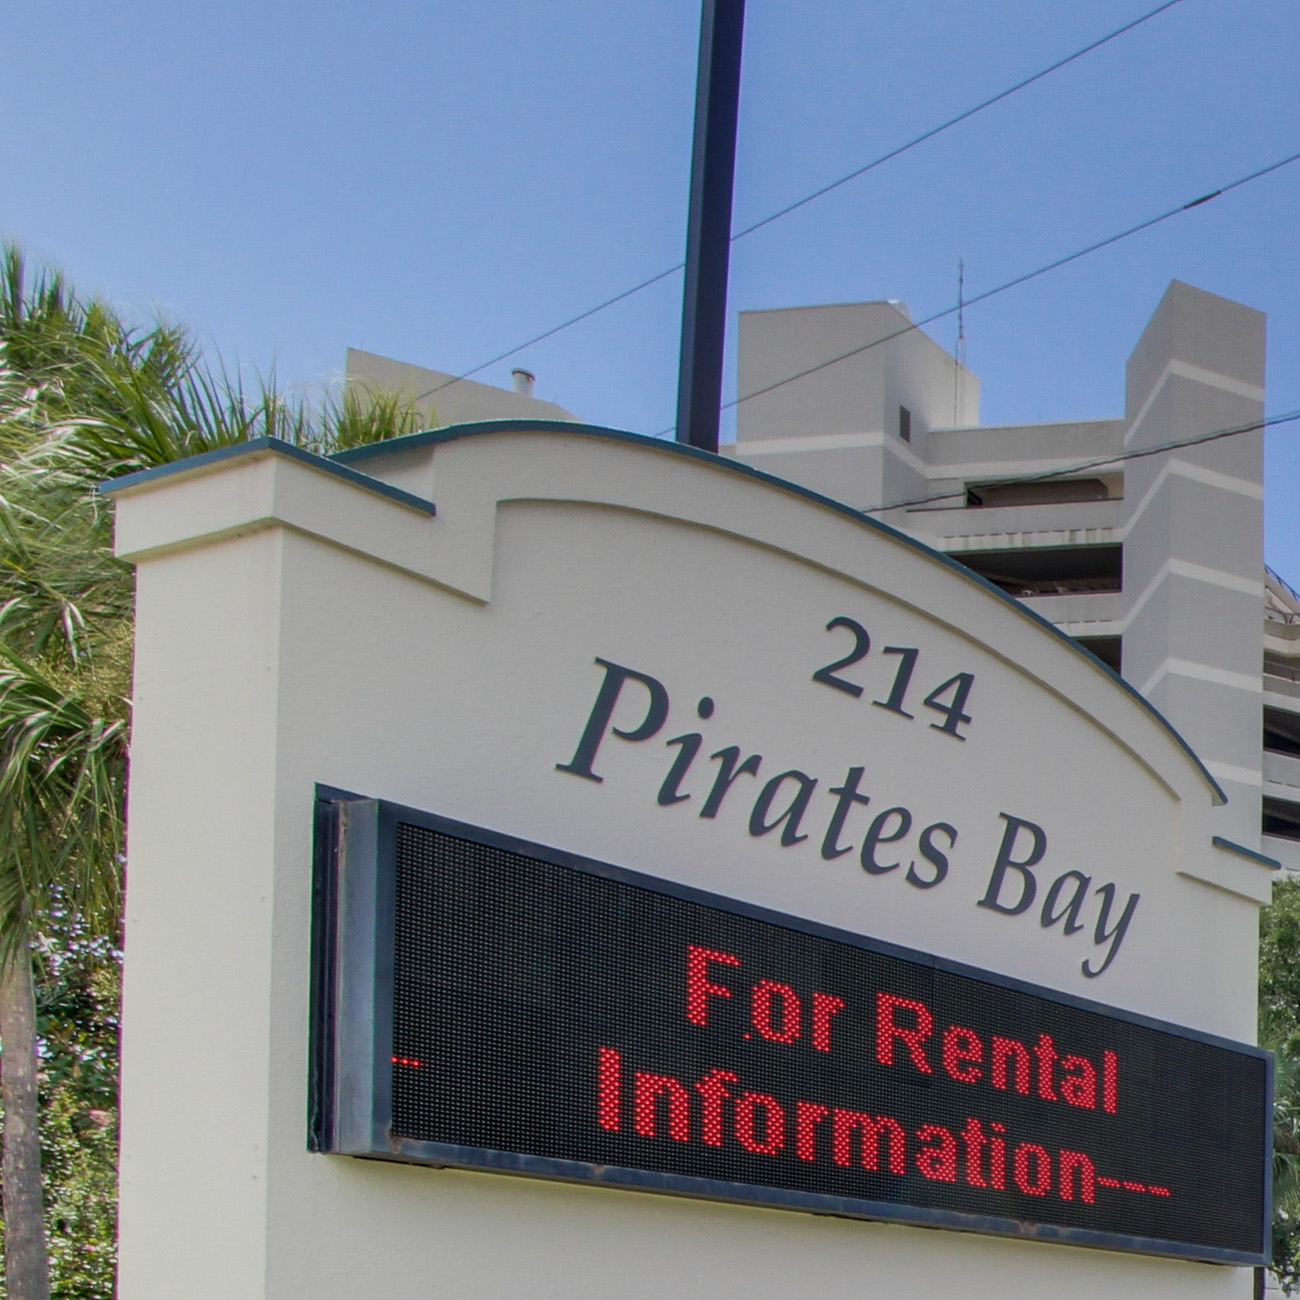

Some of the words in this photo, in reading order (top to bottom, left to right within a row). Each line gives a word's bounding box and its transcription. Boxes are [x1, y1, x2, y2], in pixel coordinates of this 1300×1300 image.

[811, 616, 975, 742] 214
[555, 657, 958, 890] Pirates
[977, 812, 1140, 979] Bay
[687, 945, 846, 1052] For
[875, 992, 1118, 1114] Rental
